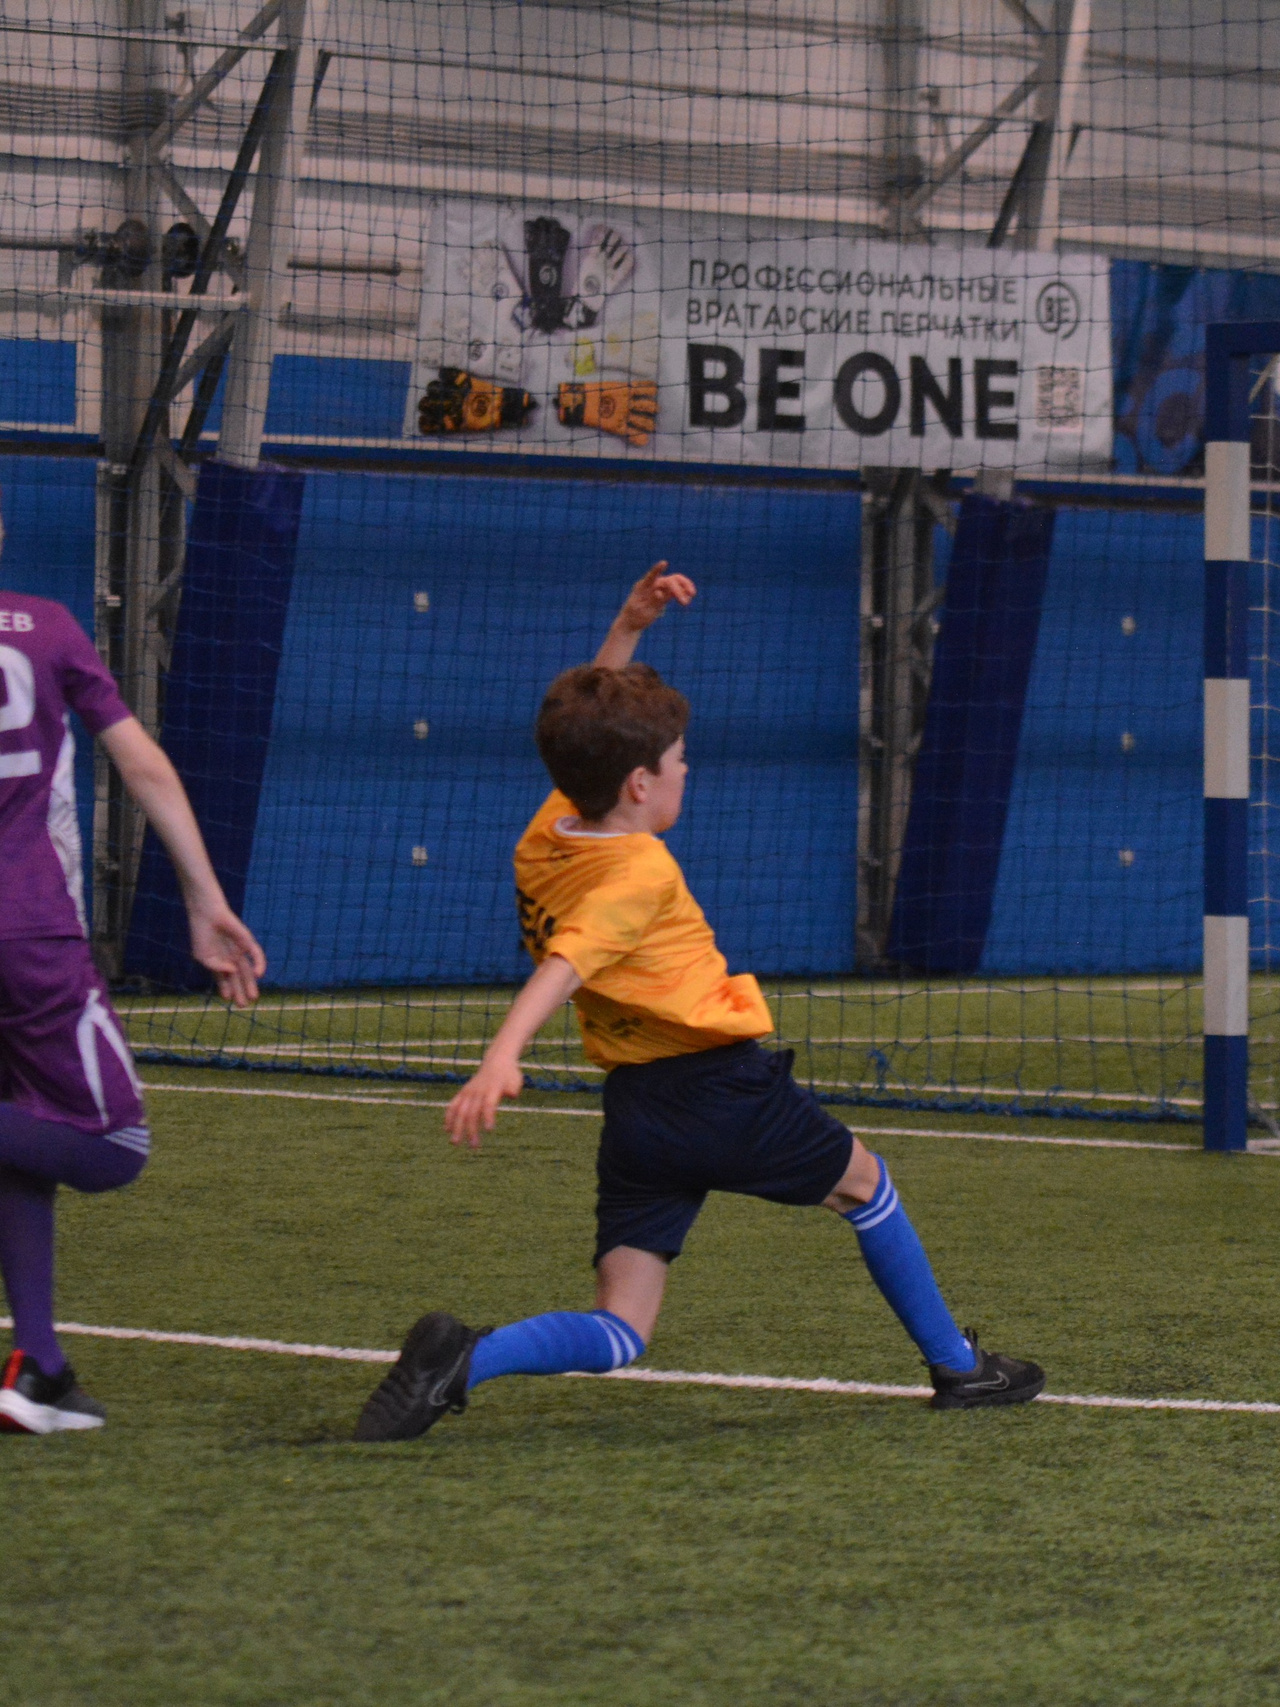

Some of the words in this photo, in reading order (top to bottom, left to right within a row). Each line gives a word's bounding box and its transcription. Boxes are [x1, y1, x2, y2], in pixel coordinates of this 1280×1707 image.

[688, 258, 1018, 304] ПРОФЕССИОНАЛЬНЫЕ
[687, 299, 870, 334] ВРАТАРСКИЕ
[880, 310, 1020, 342] ПЕРЧАТКИ
[687, 342, 806, 433] BE
[832, 351, 1019, 440] ONE
